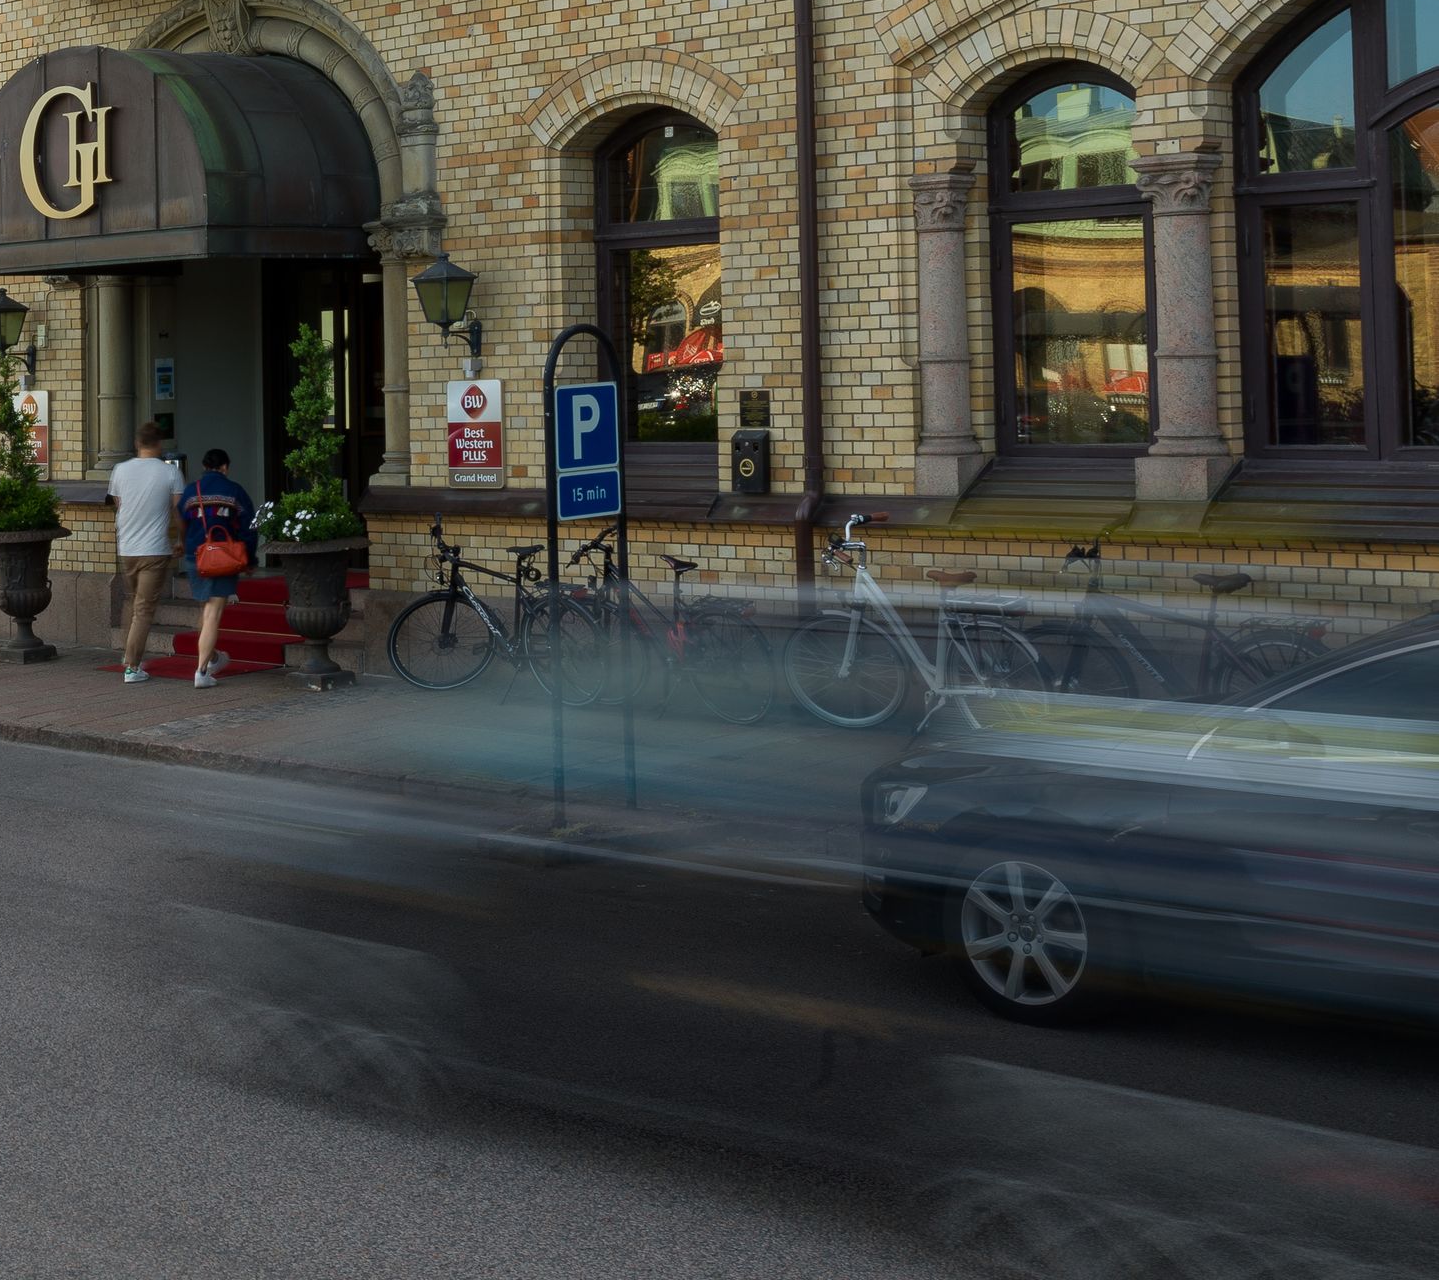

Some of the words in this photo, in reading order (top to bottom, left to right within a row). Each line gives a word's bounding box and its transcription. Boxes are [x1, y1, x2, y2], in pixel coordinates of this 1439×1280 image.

[464, 395, 483, 408] BW
[464, 427, 485, 438] Best
[572, 394, 600, 460] P
[455, 438, 493, 449] Western
[462, 450, 487, 461] PLUS
[454, 473, 475, 482] Grand
[477, 473, 497, 482] Hotel
[572, 488, 583, 502] 15
[587, 486, 606, 501] min
